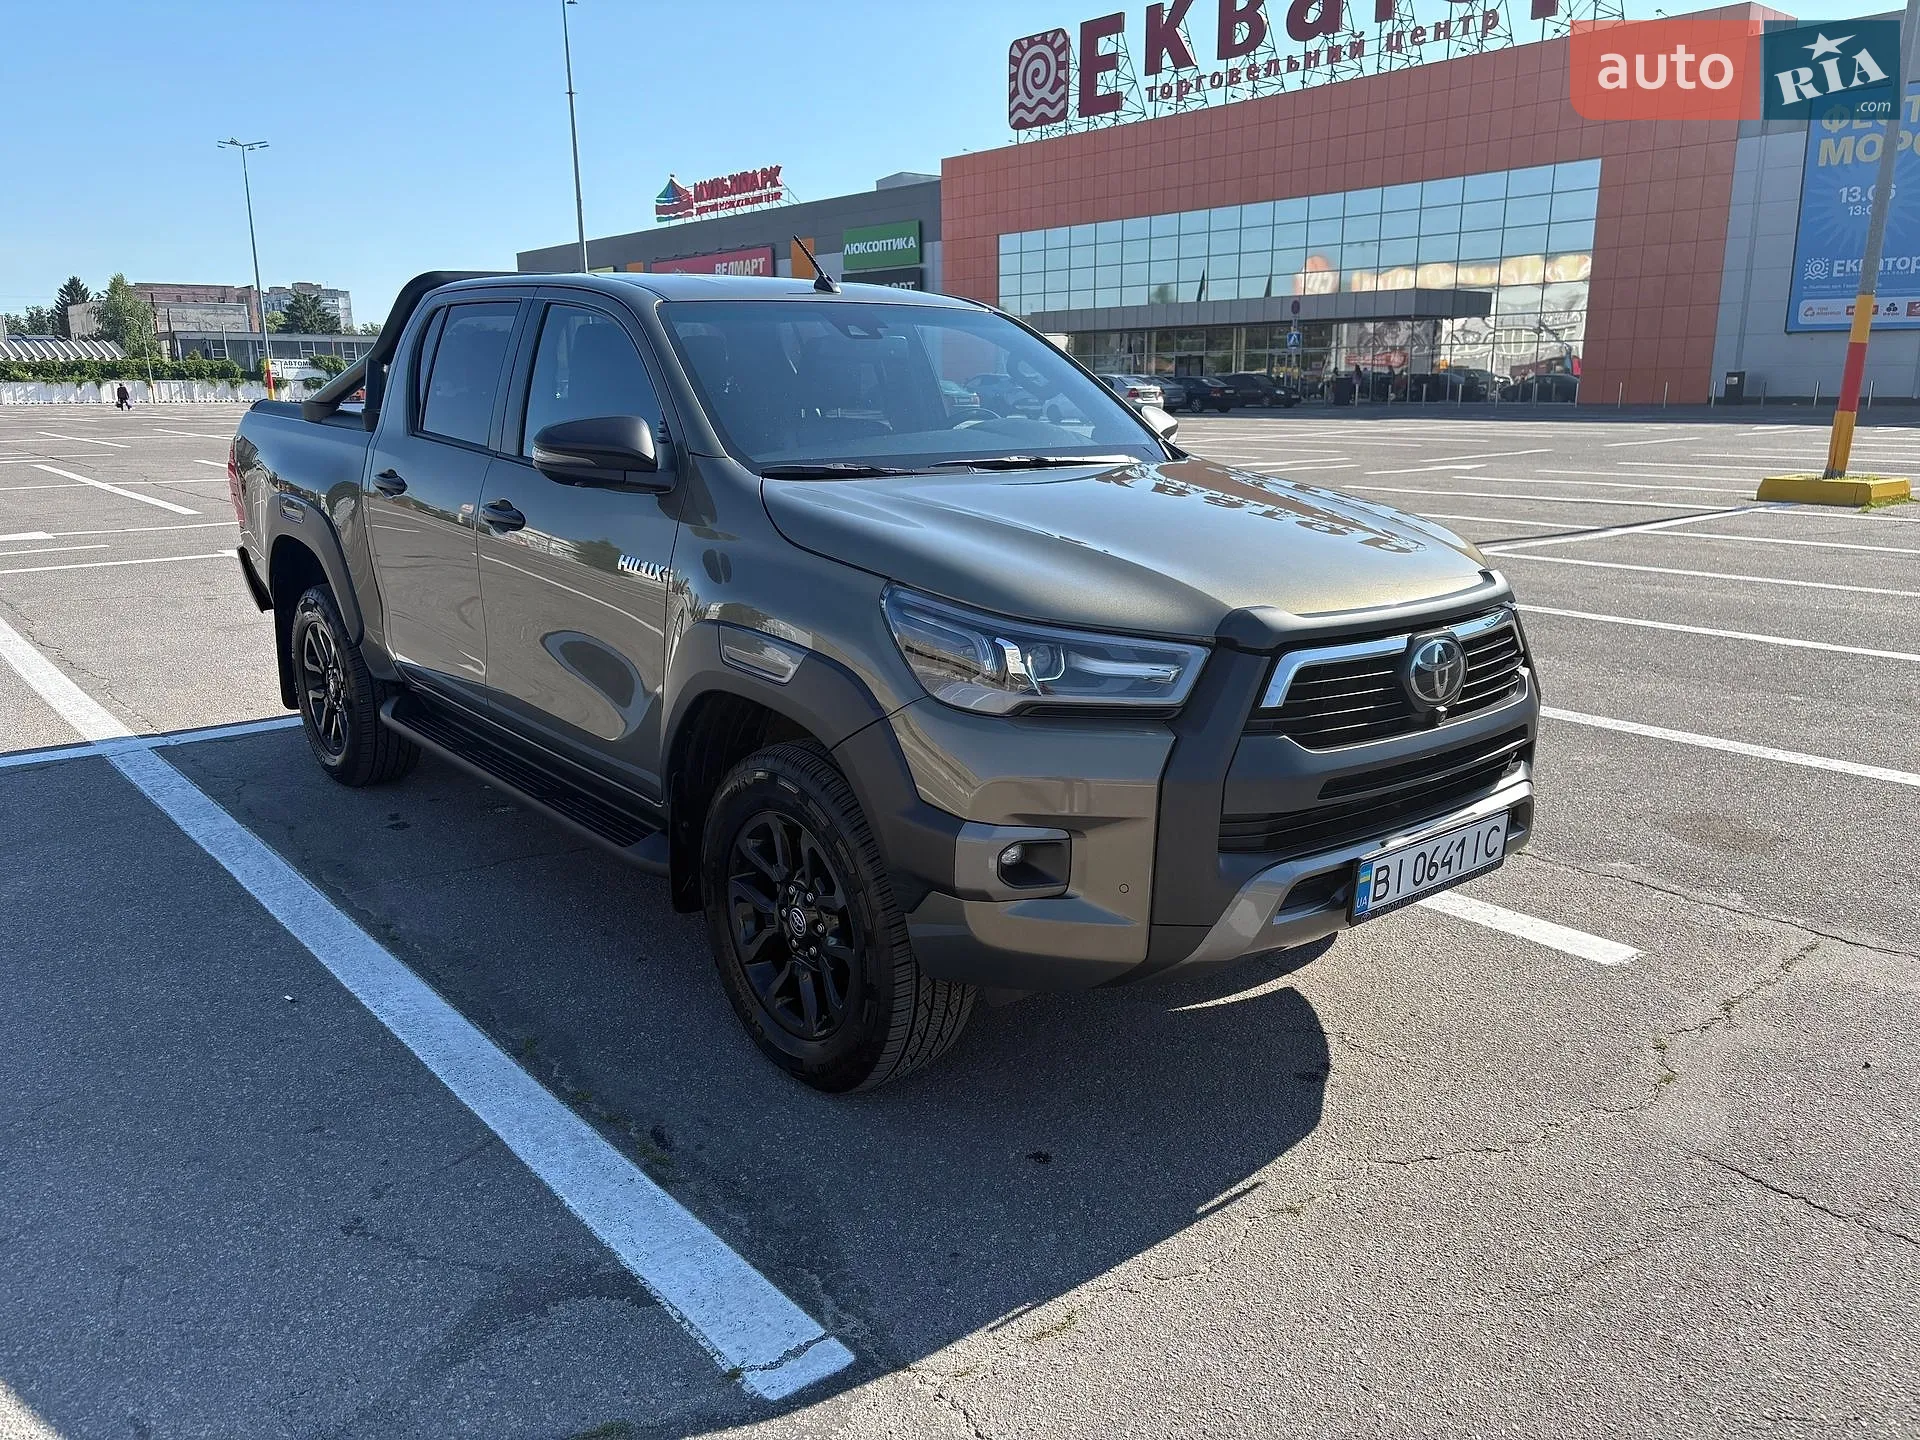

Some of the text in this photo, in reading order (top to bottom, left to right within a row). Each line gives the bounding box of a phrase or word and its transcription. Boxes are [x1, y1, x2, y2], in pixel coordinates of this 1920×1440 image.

[1146, 8, 1500, 102] торговельний центр
[844, 236, 916, 255] ЛЮКСОПТИКА
[617, 554, 666, 582] HILUX
[1372, 859, 1403, 902] BI
[1412, 837, 1466, 886] 0641
[1473, 825, 1500, 864] IC
[1356, 896, 1368, 908] UA
